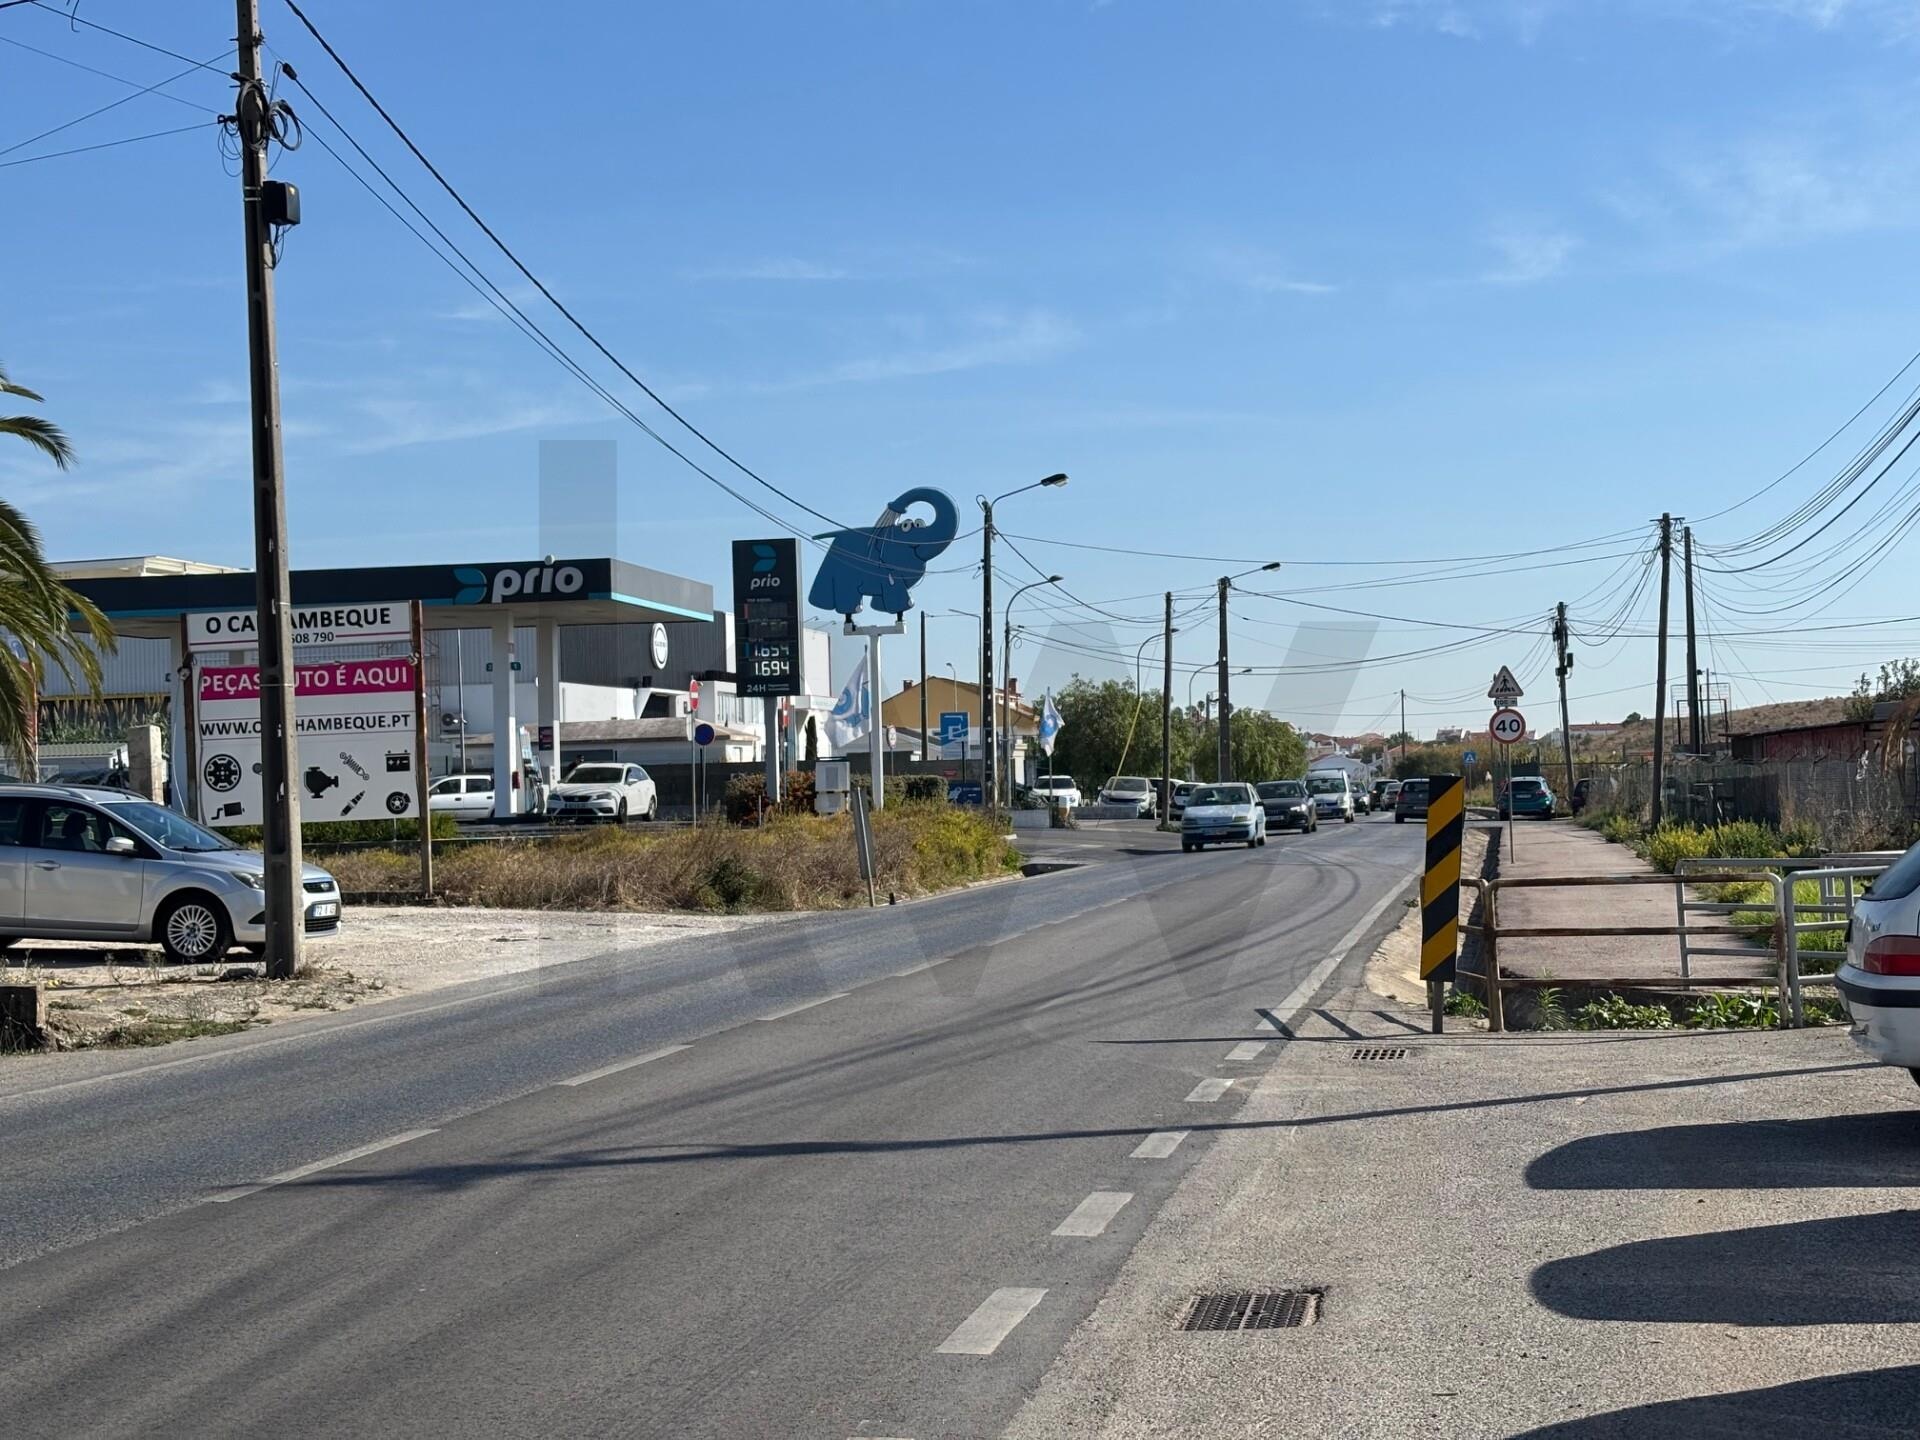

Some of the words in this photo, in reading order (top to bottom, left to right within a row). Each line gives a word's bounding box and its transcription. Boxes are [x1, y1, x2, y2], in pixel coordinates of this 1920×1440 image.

[491, 554, 584, 603] prio
[750, 573, 781, 590] prio
[206, 616, 222, 633] O
[228, 608, 391, 633] CAMBEQUE
[313, 632, 334, 643] 790
[754, 660, 790, 676] 1.694
[201, 673, 260, 695] PEÇAS
[294, 671, 329, 688] TO
[336, 665, 347, 687] É
[353, 666, 408, 687] AQUI
[747, 684, 766, 693] 24H
[200, 714, 411, 736] WWW.OHAMBEQUE.PT
[1495, 719, 1521, 732] 40
